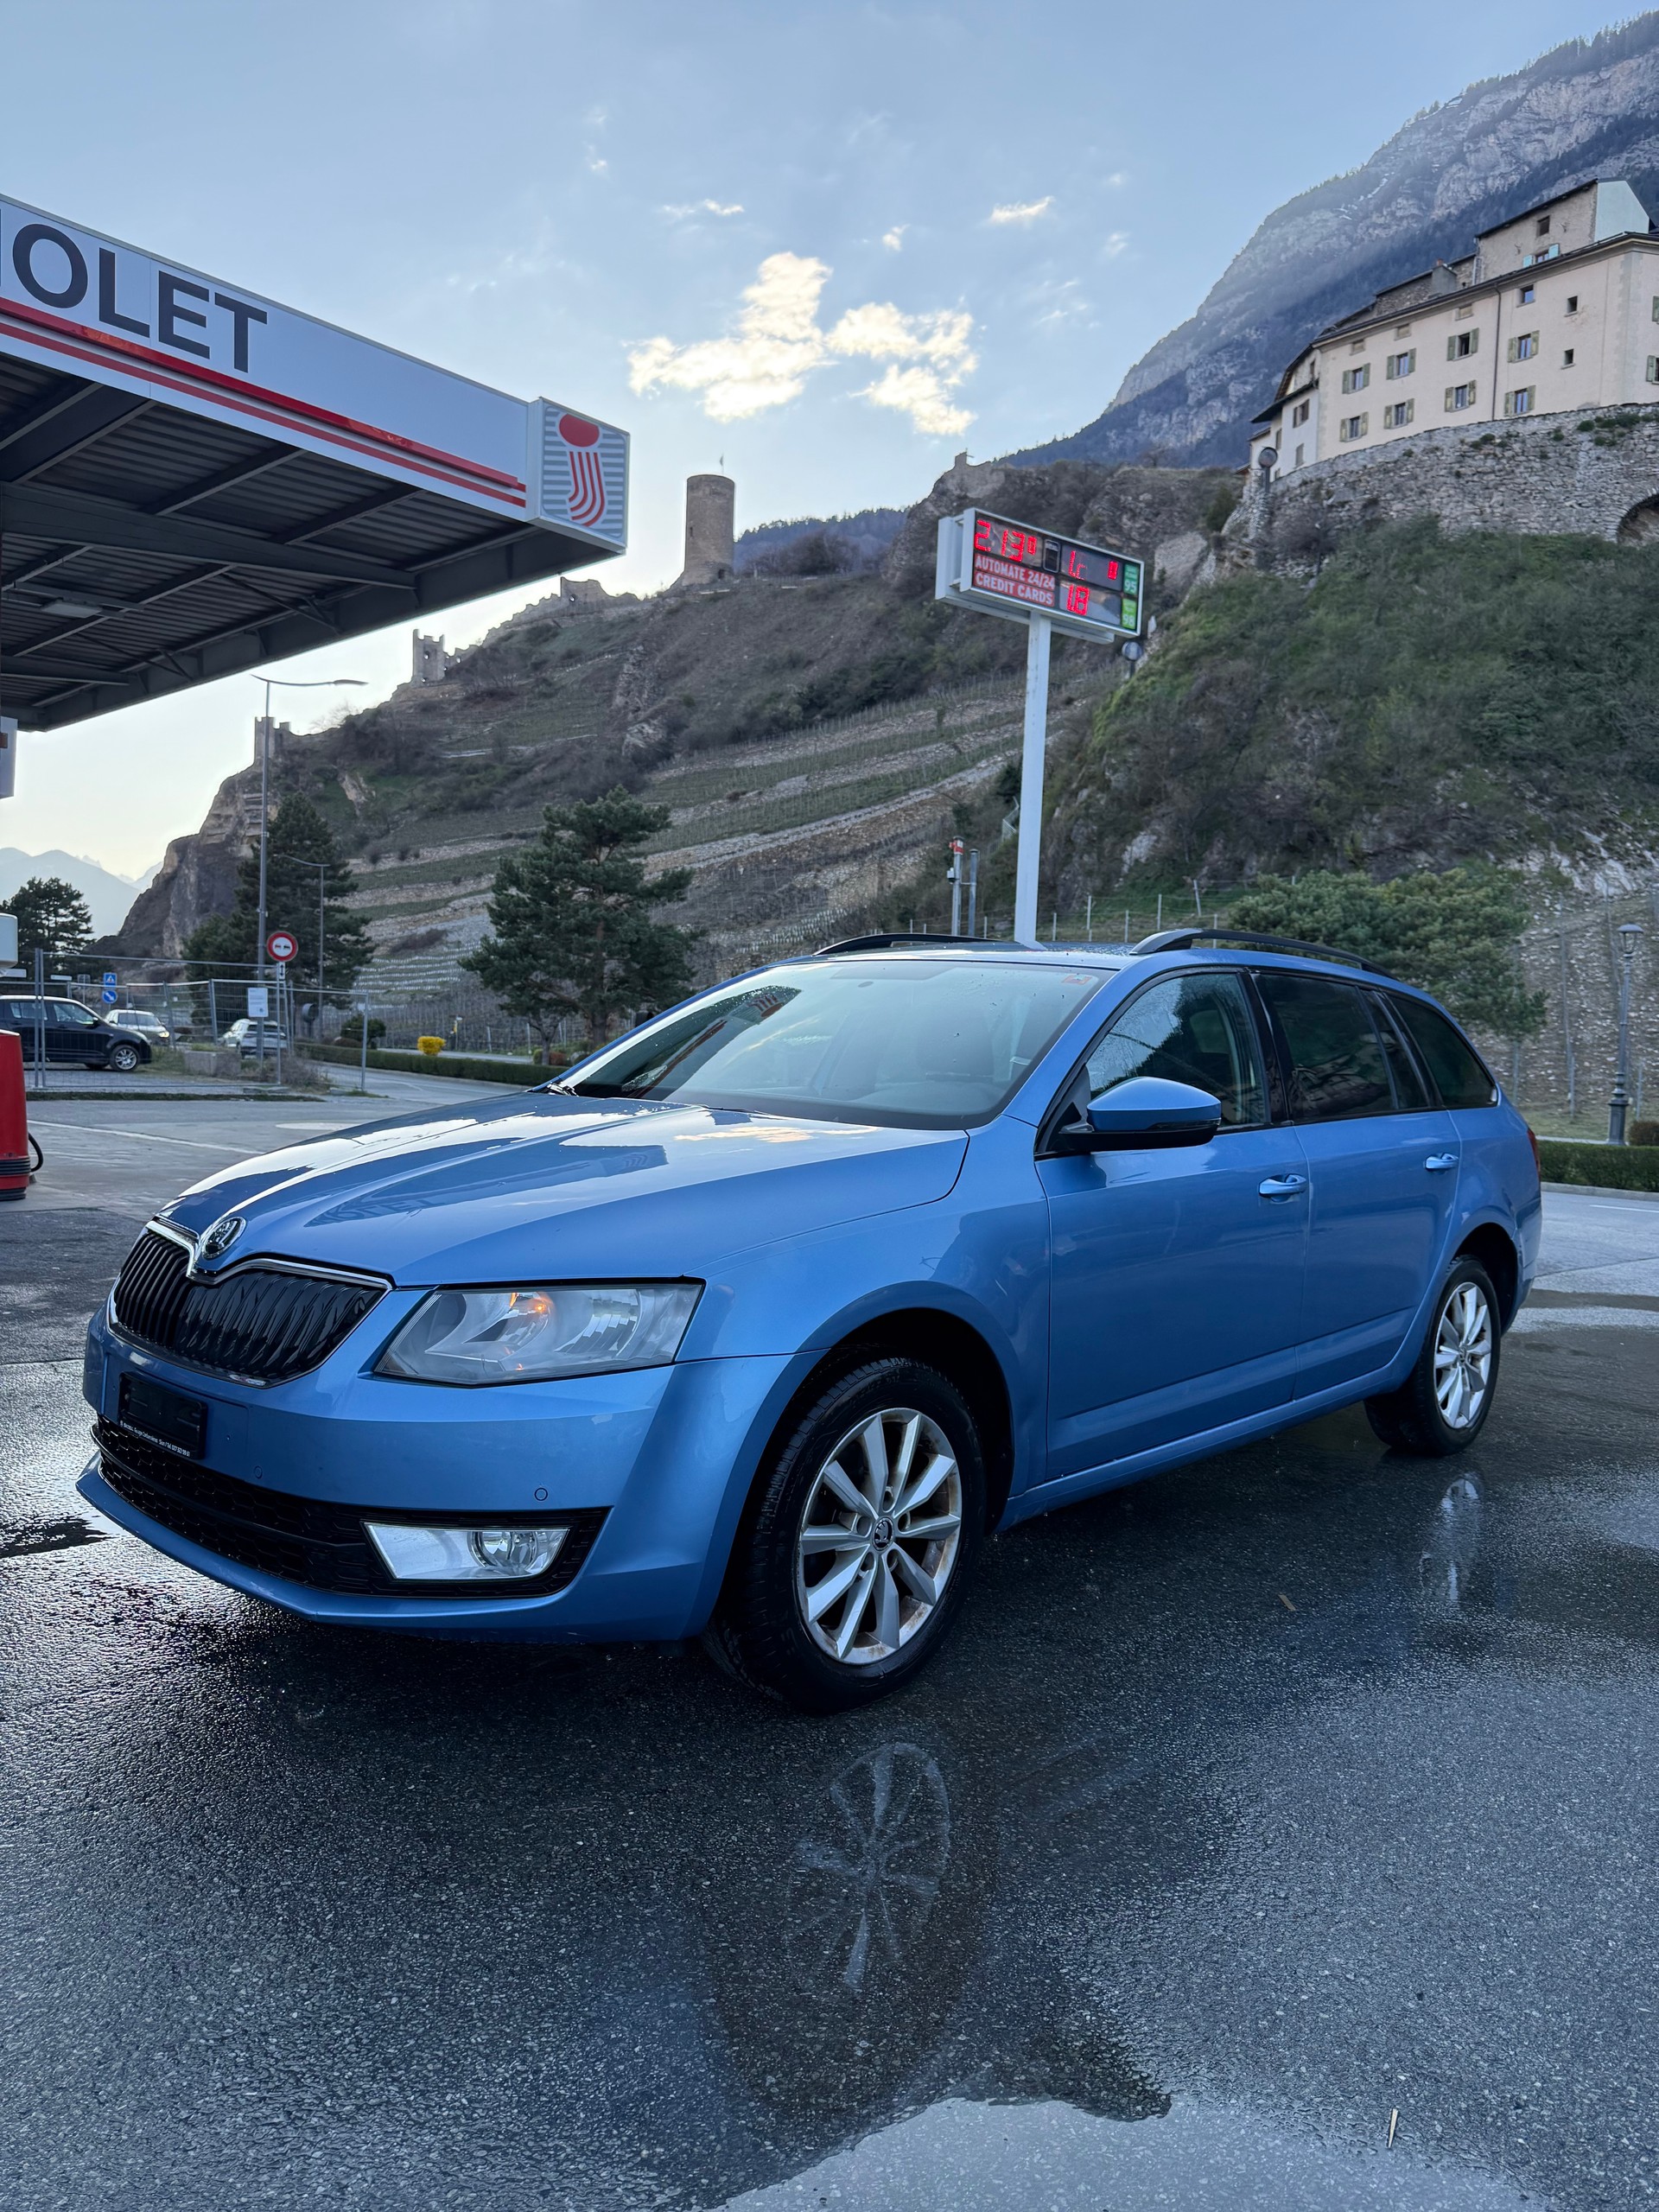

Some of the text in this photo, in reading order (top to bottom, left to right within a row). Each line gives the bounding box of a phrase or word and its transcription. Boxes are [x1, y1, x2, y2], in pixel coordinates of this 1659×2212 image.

[0, 209, 268, 373] OLET
[975, 555, 1055, 590] AUTOMATE 24/24
[976, 572, 1053, 605] CREDIT CARDS
[1124, 580, 1137, 594] 95
[1122, 613, 1135, 627] 98
